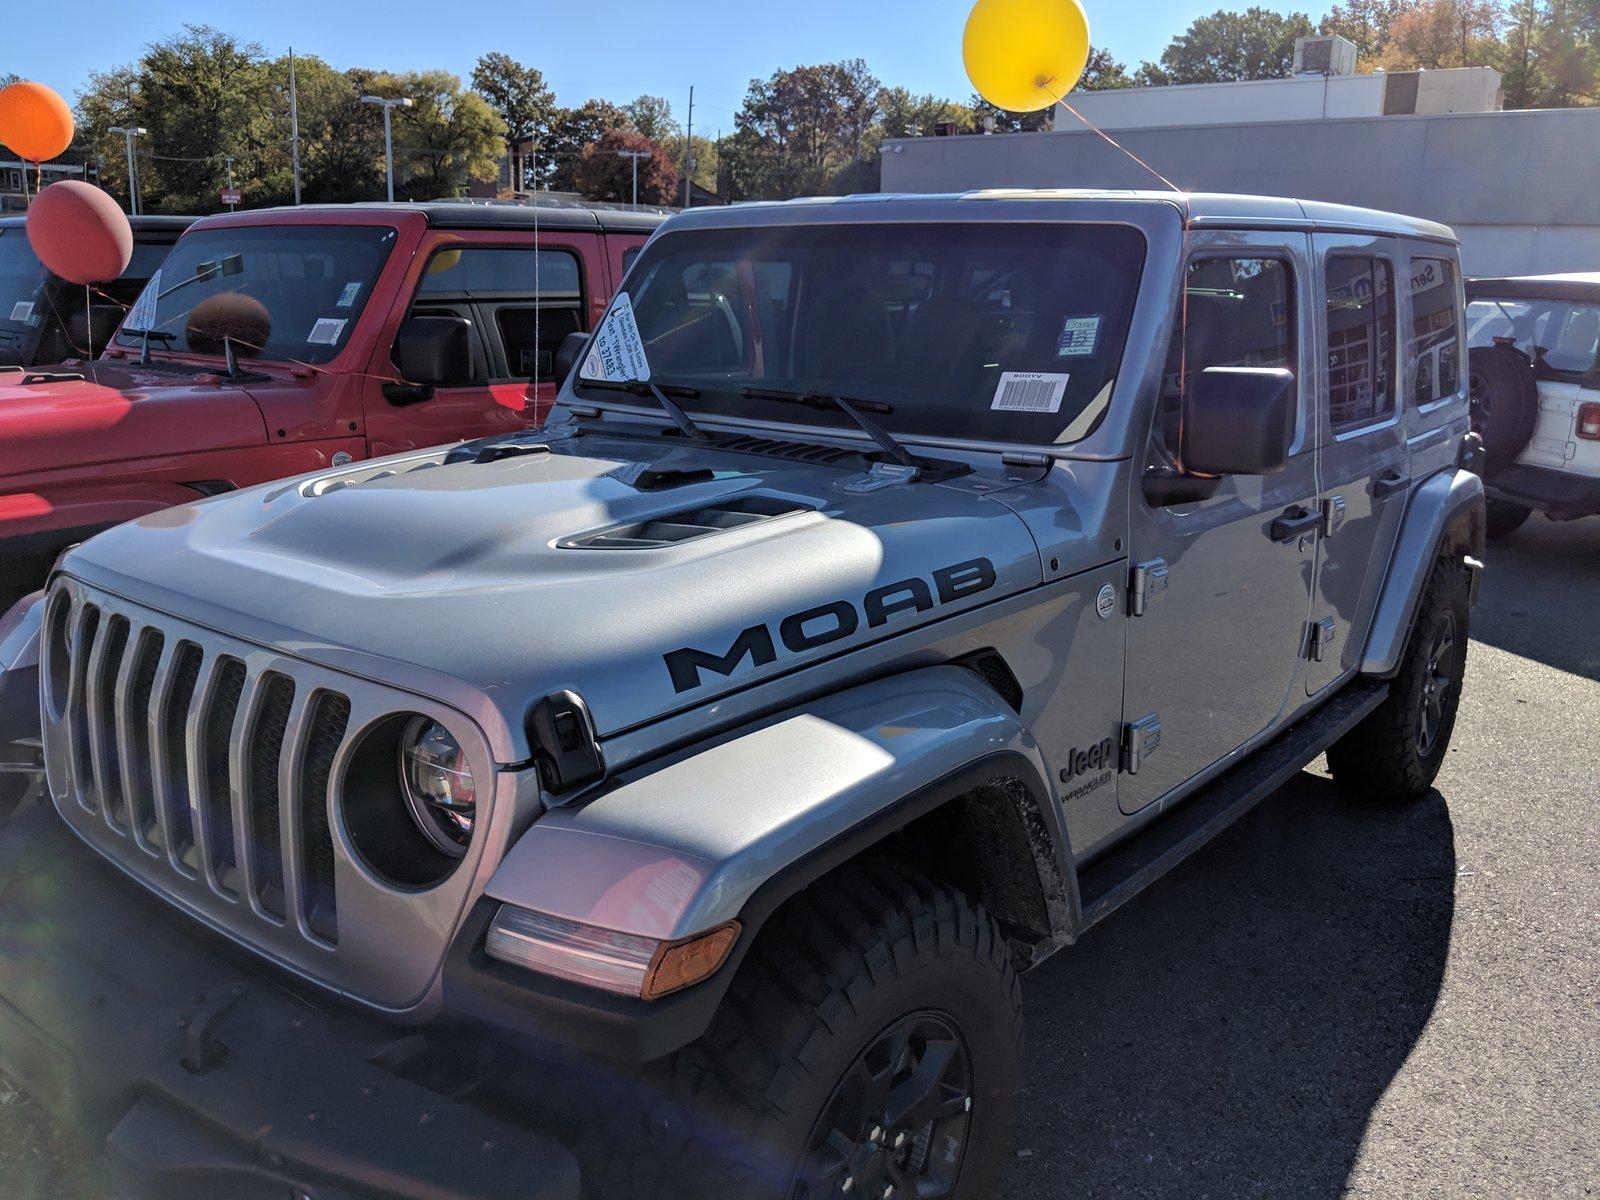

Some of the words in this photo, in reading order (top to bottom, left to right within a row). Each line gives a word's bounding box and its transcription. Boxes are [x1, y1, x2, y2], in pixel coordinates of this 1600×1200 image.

[607, 318, 616, 336] Text
[599, 336, 606, 347] to
[602, 347, 616, 375] 37483
[662, 556, 997, 694] MOAB
[1060, 737, 1113, 783] Jeep
